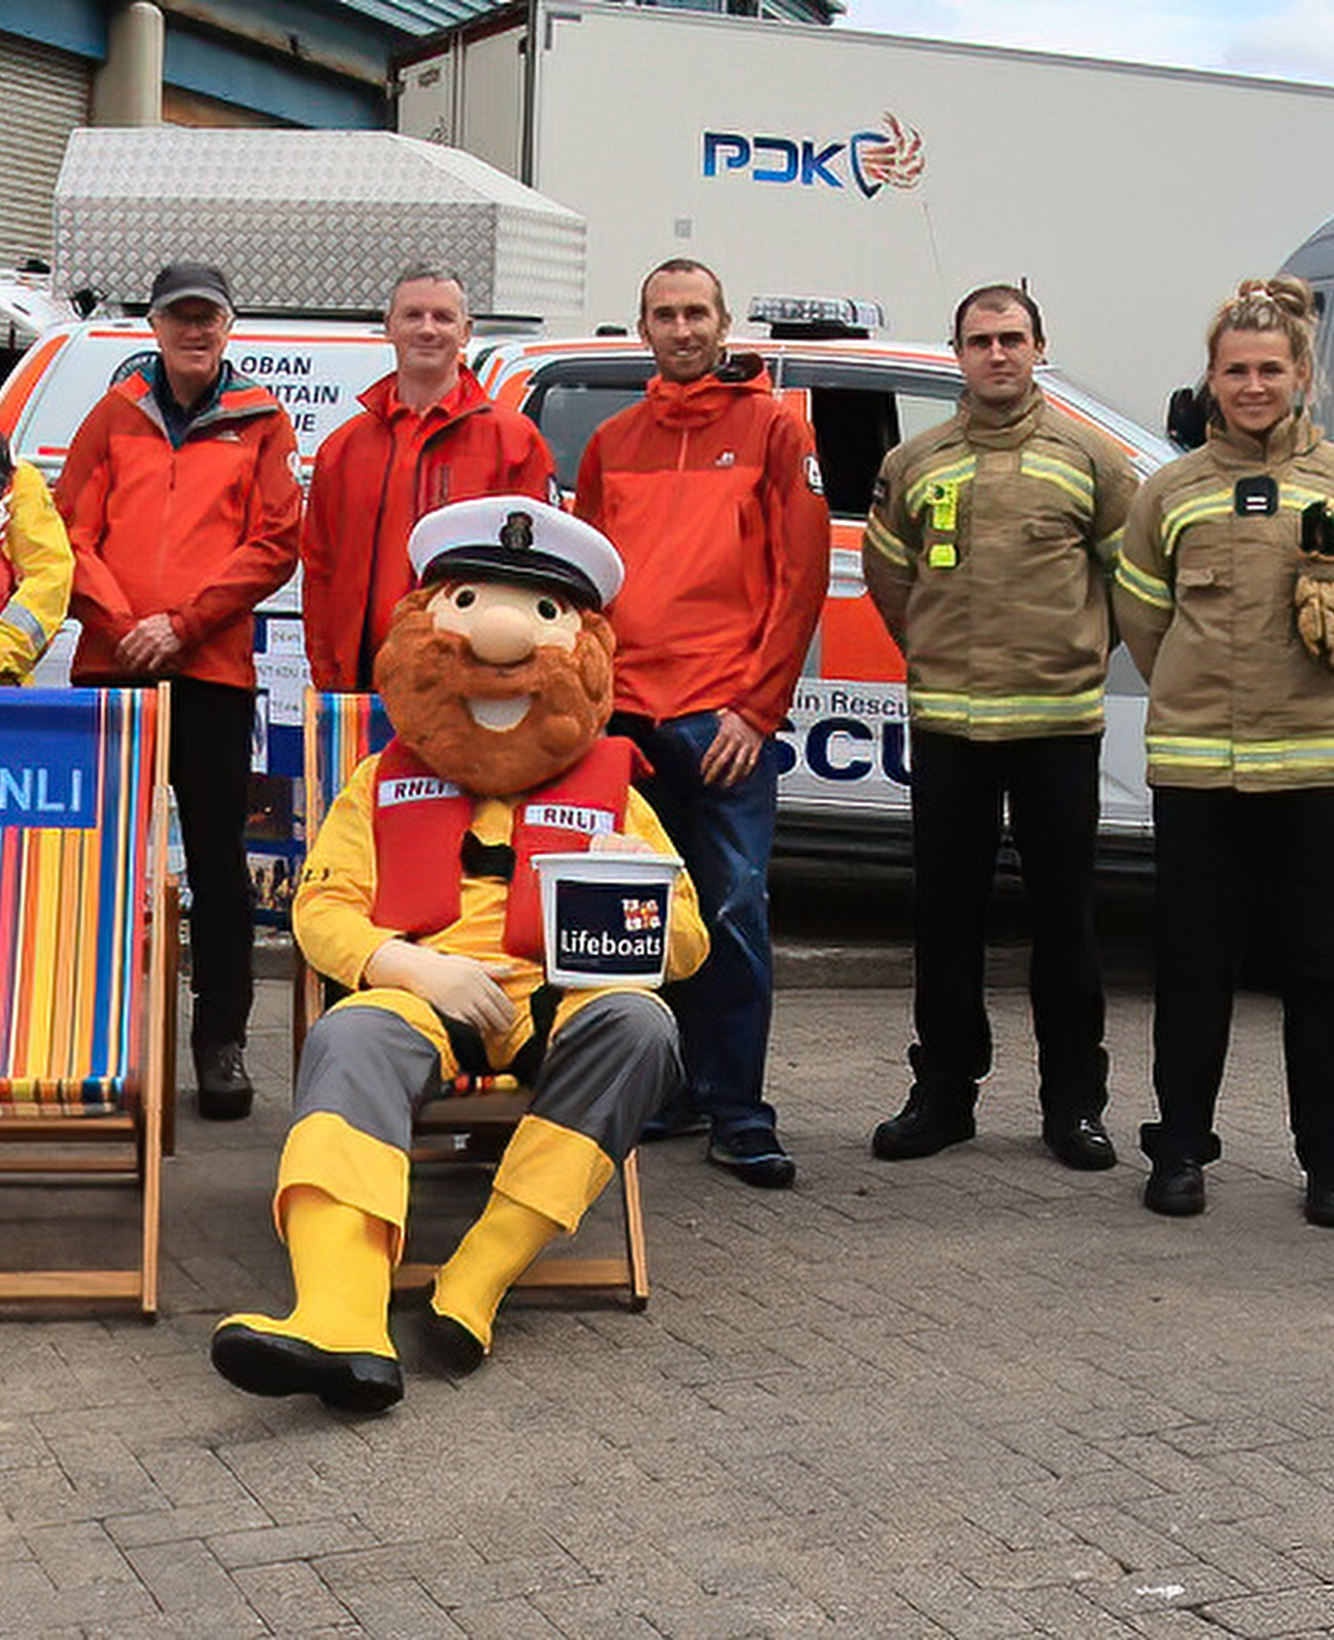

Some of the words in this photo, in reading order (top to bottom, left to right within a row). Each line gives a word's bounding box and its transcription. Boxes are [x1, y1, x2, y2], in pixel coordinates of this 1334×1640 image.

[703, 132, 846, 188] PDK
[240, 356, 312, 375] OBAN
[267, 385, 339, 404] NTAIN
[831, 690, 911, 717] Rescu
[394, 778, 446, 800] RNLI
[543, 807, 596, 831] RNLI
[561, 929, 661, 956] Lifeboats
